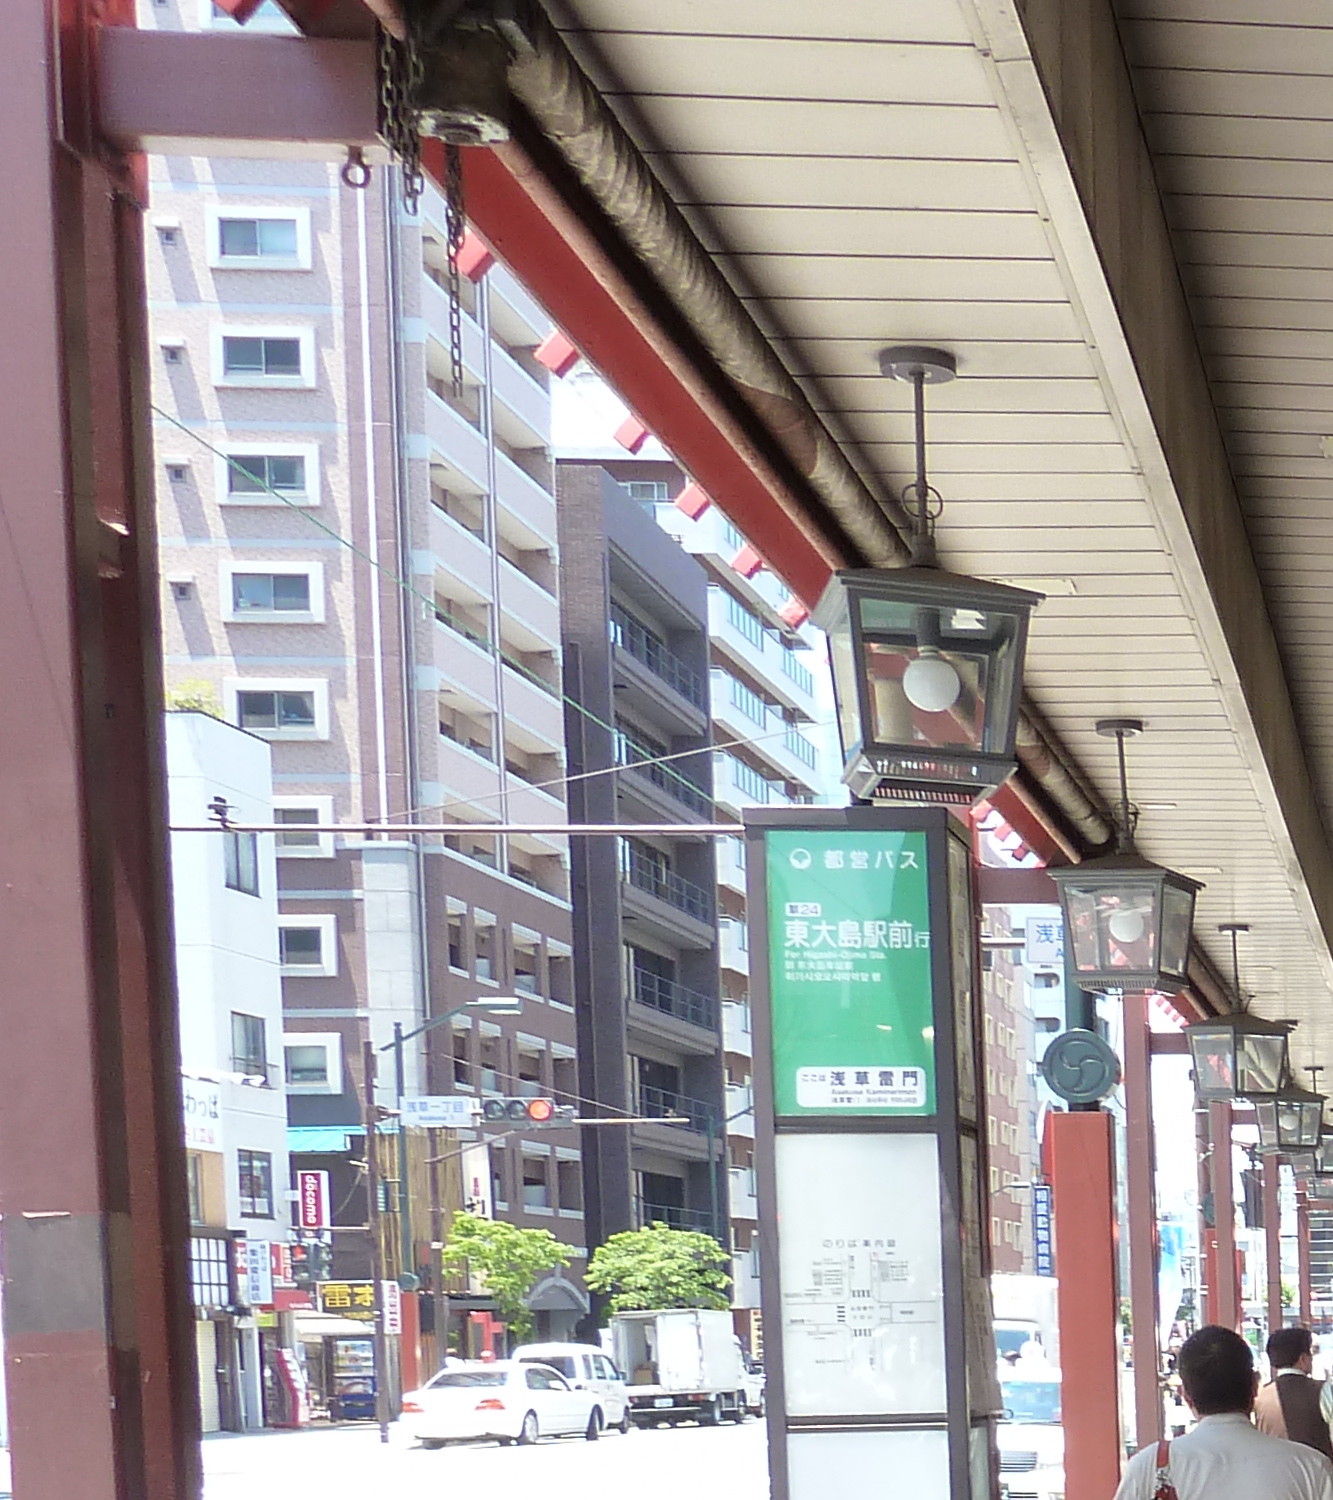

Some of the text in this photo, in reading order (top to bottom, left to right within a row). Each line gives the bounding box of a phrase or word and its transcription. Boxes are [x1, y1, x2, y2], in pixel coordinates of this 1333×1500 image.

[824, 850, 918, 869] 都営バス
[784, 919, 930, 949] 東大島駅前行
[830, 1070, 918, 1086] 浅草雷門
[407, 1101, 463, 1112] 浅草一丁目
[305, 1175, 317, 1224] docomo
